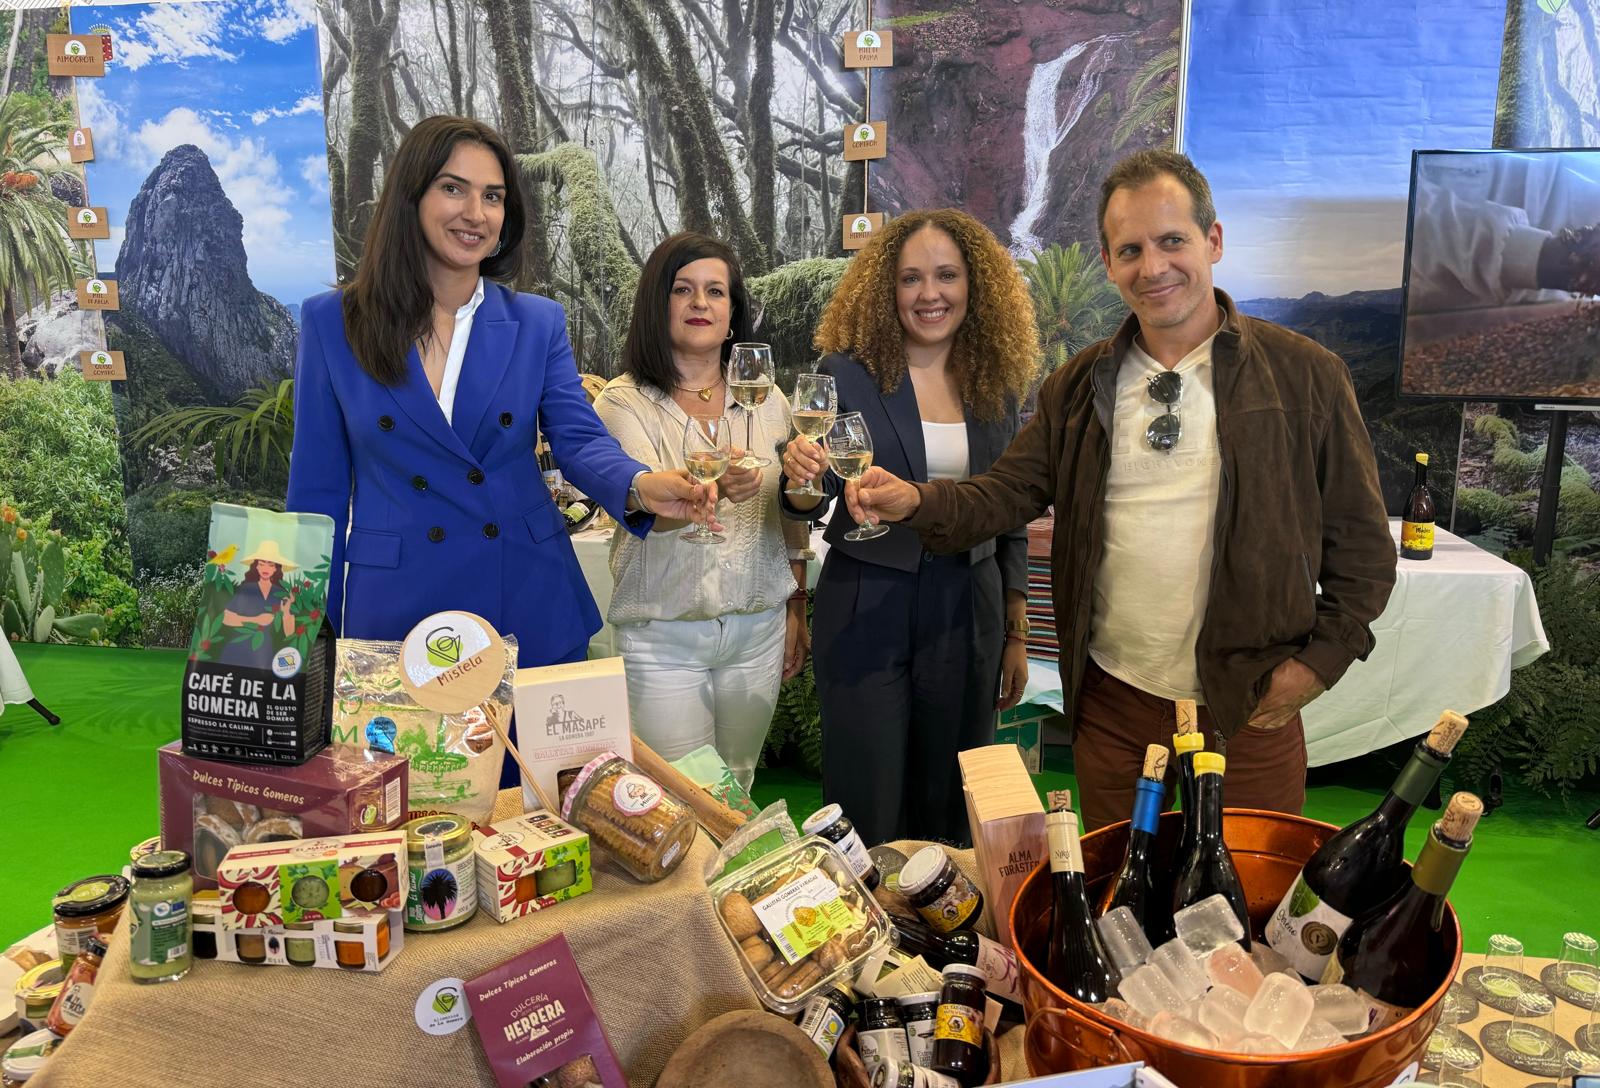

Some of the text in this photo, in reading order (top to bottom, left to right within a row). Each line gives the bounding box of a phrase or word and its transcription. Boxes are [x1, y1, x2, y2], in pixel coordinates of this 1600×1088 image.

[436, 655, 483, 686] Mistela
[188, 672, 296, 701] CAFÉ DE LA
[187, 693, 259, 719] GOMERA
[187, 716, 217, 727] ESPRESSO
[229, 723, 254, 731] CALIMA
[546, 715, 606, 736] EL MASAPÉ
[193, 769, 304, 805] Dulces Típicos Gomeros
[1009, 849, 1032, 863] ALMA
[479, 959, 557, 1001] Dulces Típicos Gomeros
[510, 992, 549, 1018] DULCERÍA
[503, 999, 566, 1042] HERRERA
[516, 1027, 574, 1066] Elaboración propia
